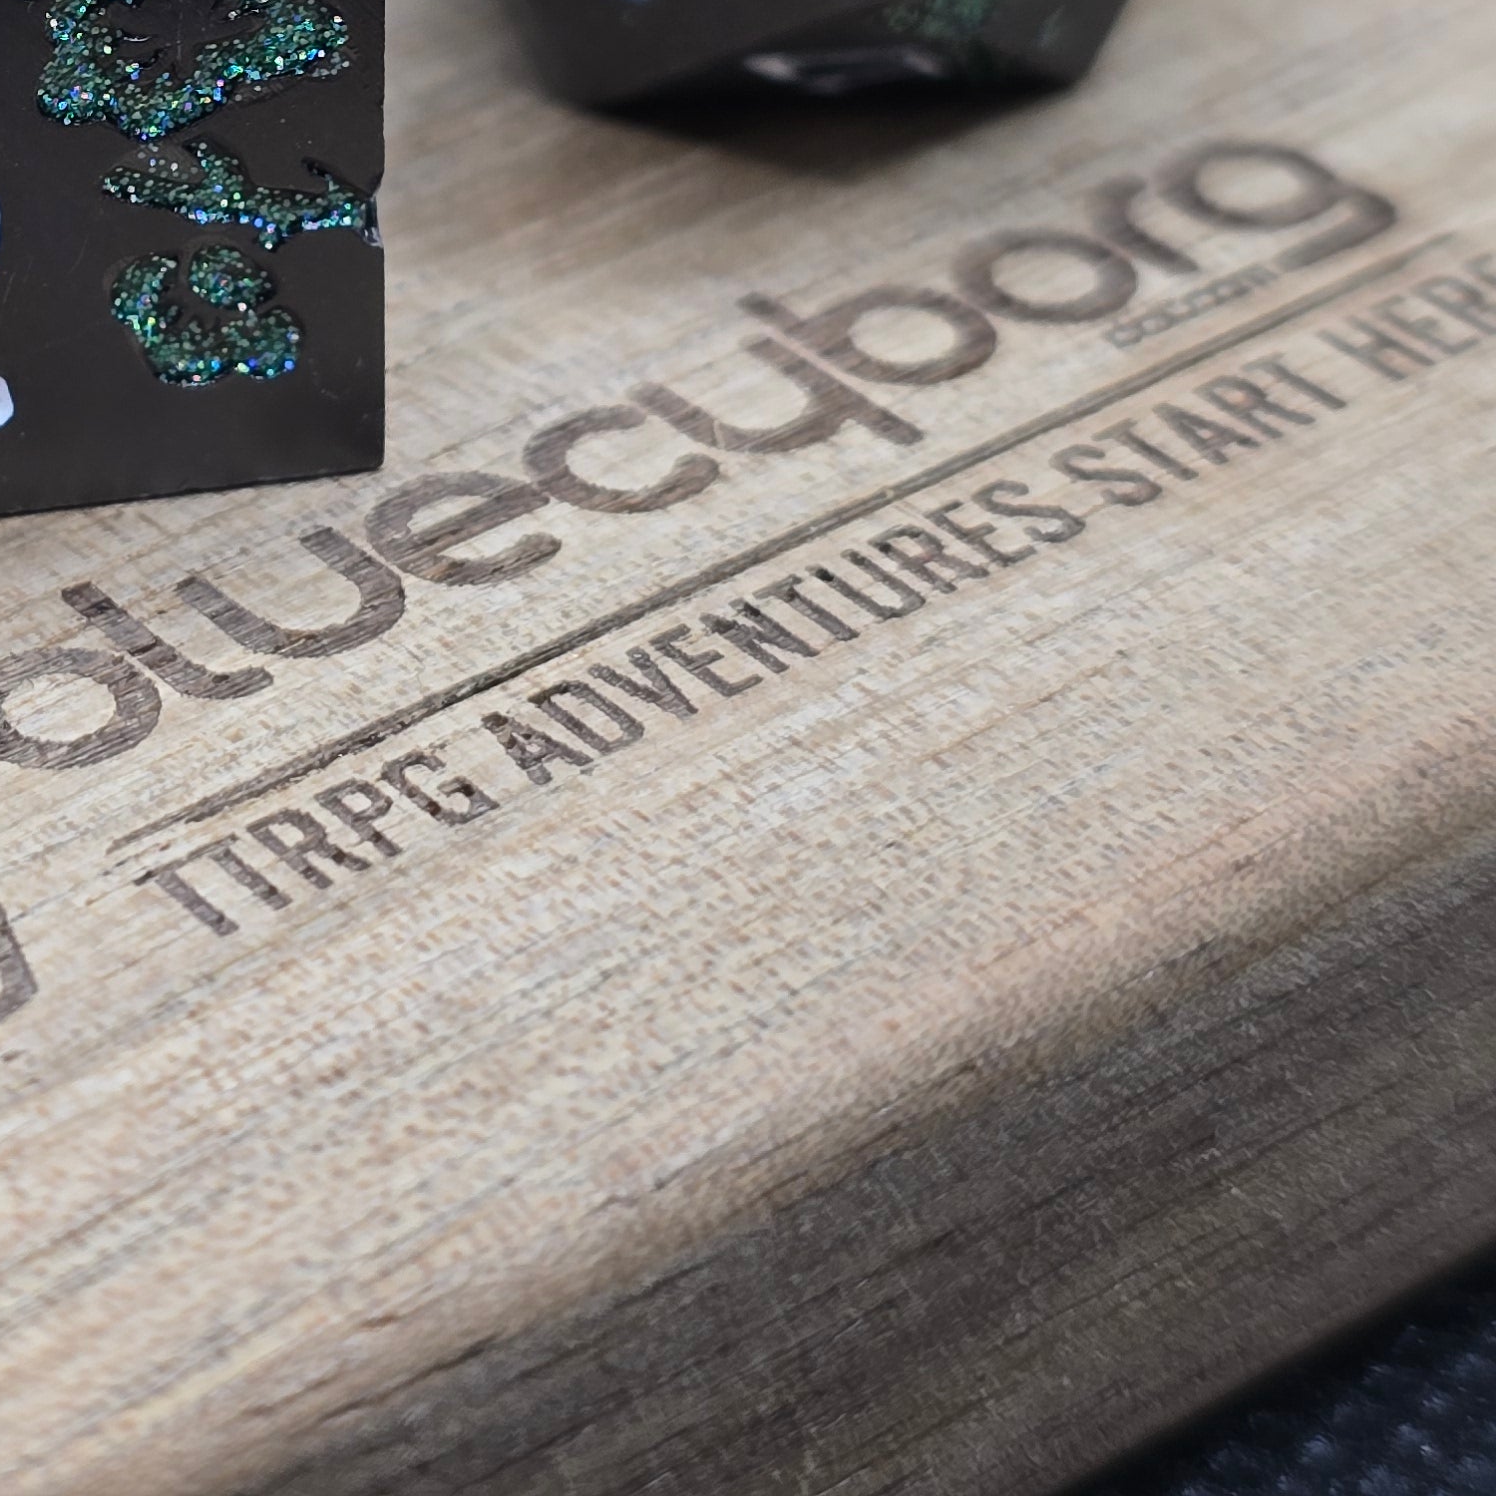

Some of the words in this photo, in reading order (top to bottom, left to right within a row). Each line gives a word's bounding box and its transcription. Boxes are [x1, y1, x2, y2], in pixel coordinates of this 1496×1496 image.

[133, 747, 500, 936] TTRPG
[481, 479, 1087, 785] ADVENTURES
[1049, 351, 1349, 507] START
